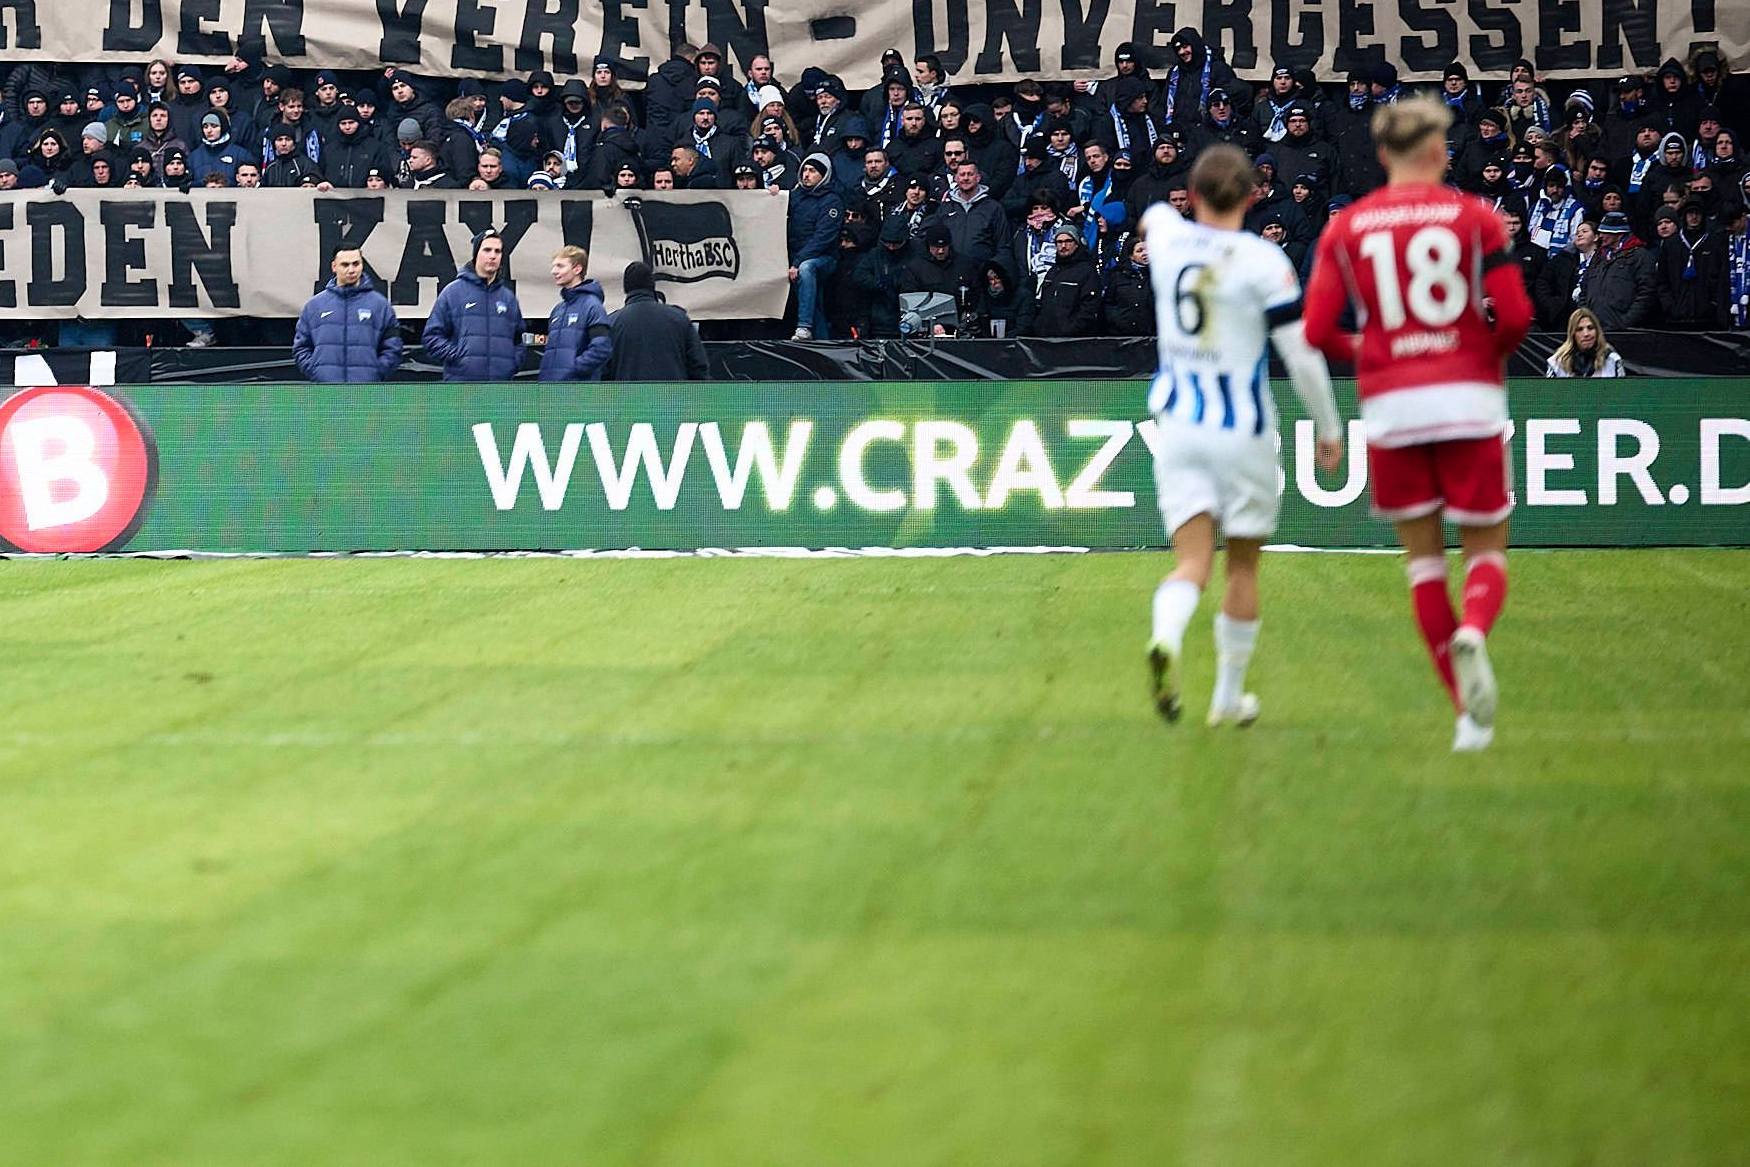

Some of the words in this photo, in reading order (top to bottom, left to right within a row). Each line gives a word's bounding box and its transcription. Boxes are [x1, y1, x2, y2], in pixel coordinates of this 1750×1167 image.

[1176, 264, 1208, 335] 6
[1359, 226, 1469, 332] 18
[8, 413, 110, 531] B
[472, 417, 1750, 511] WWW.CRAZUER.D
